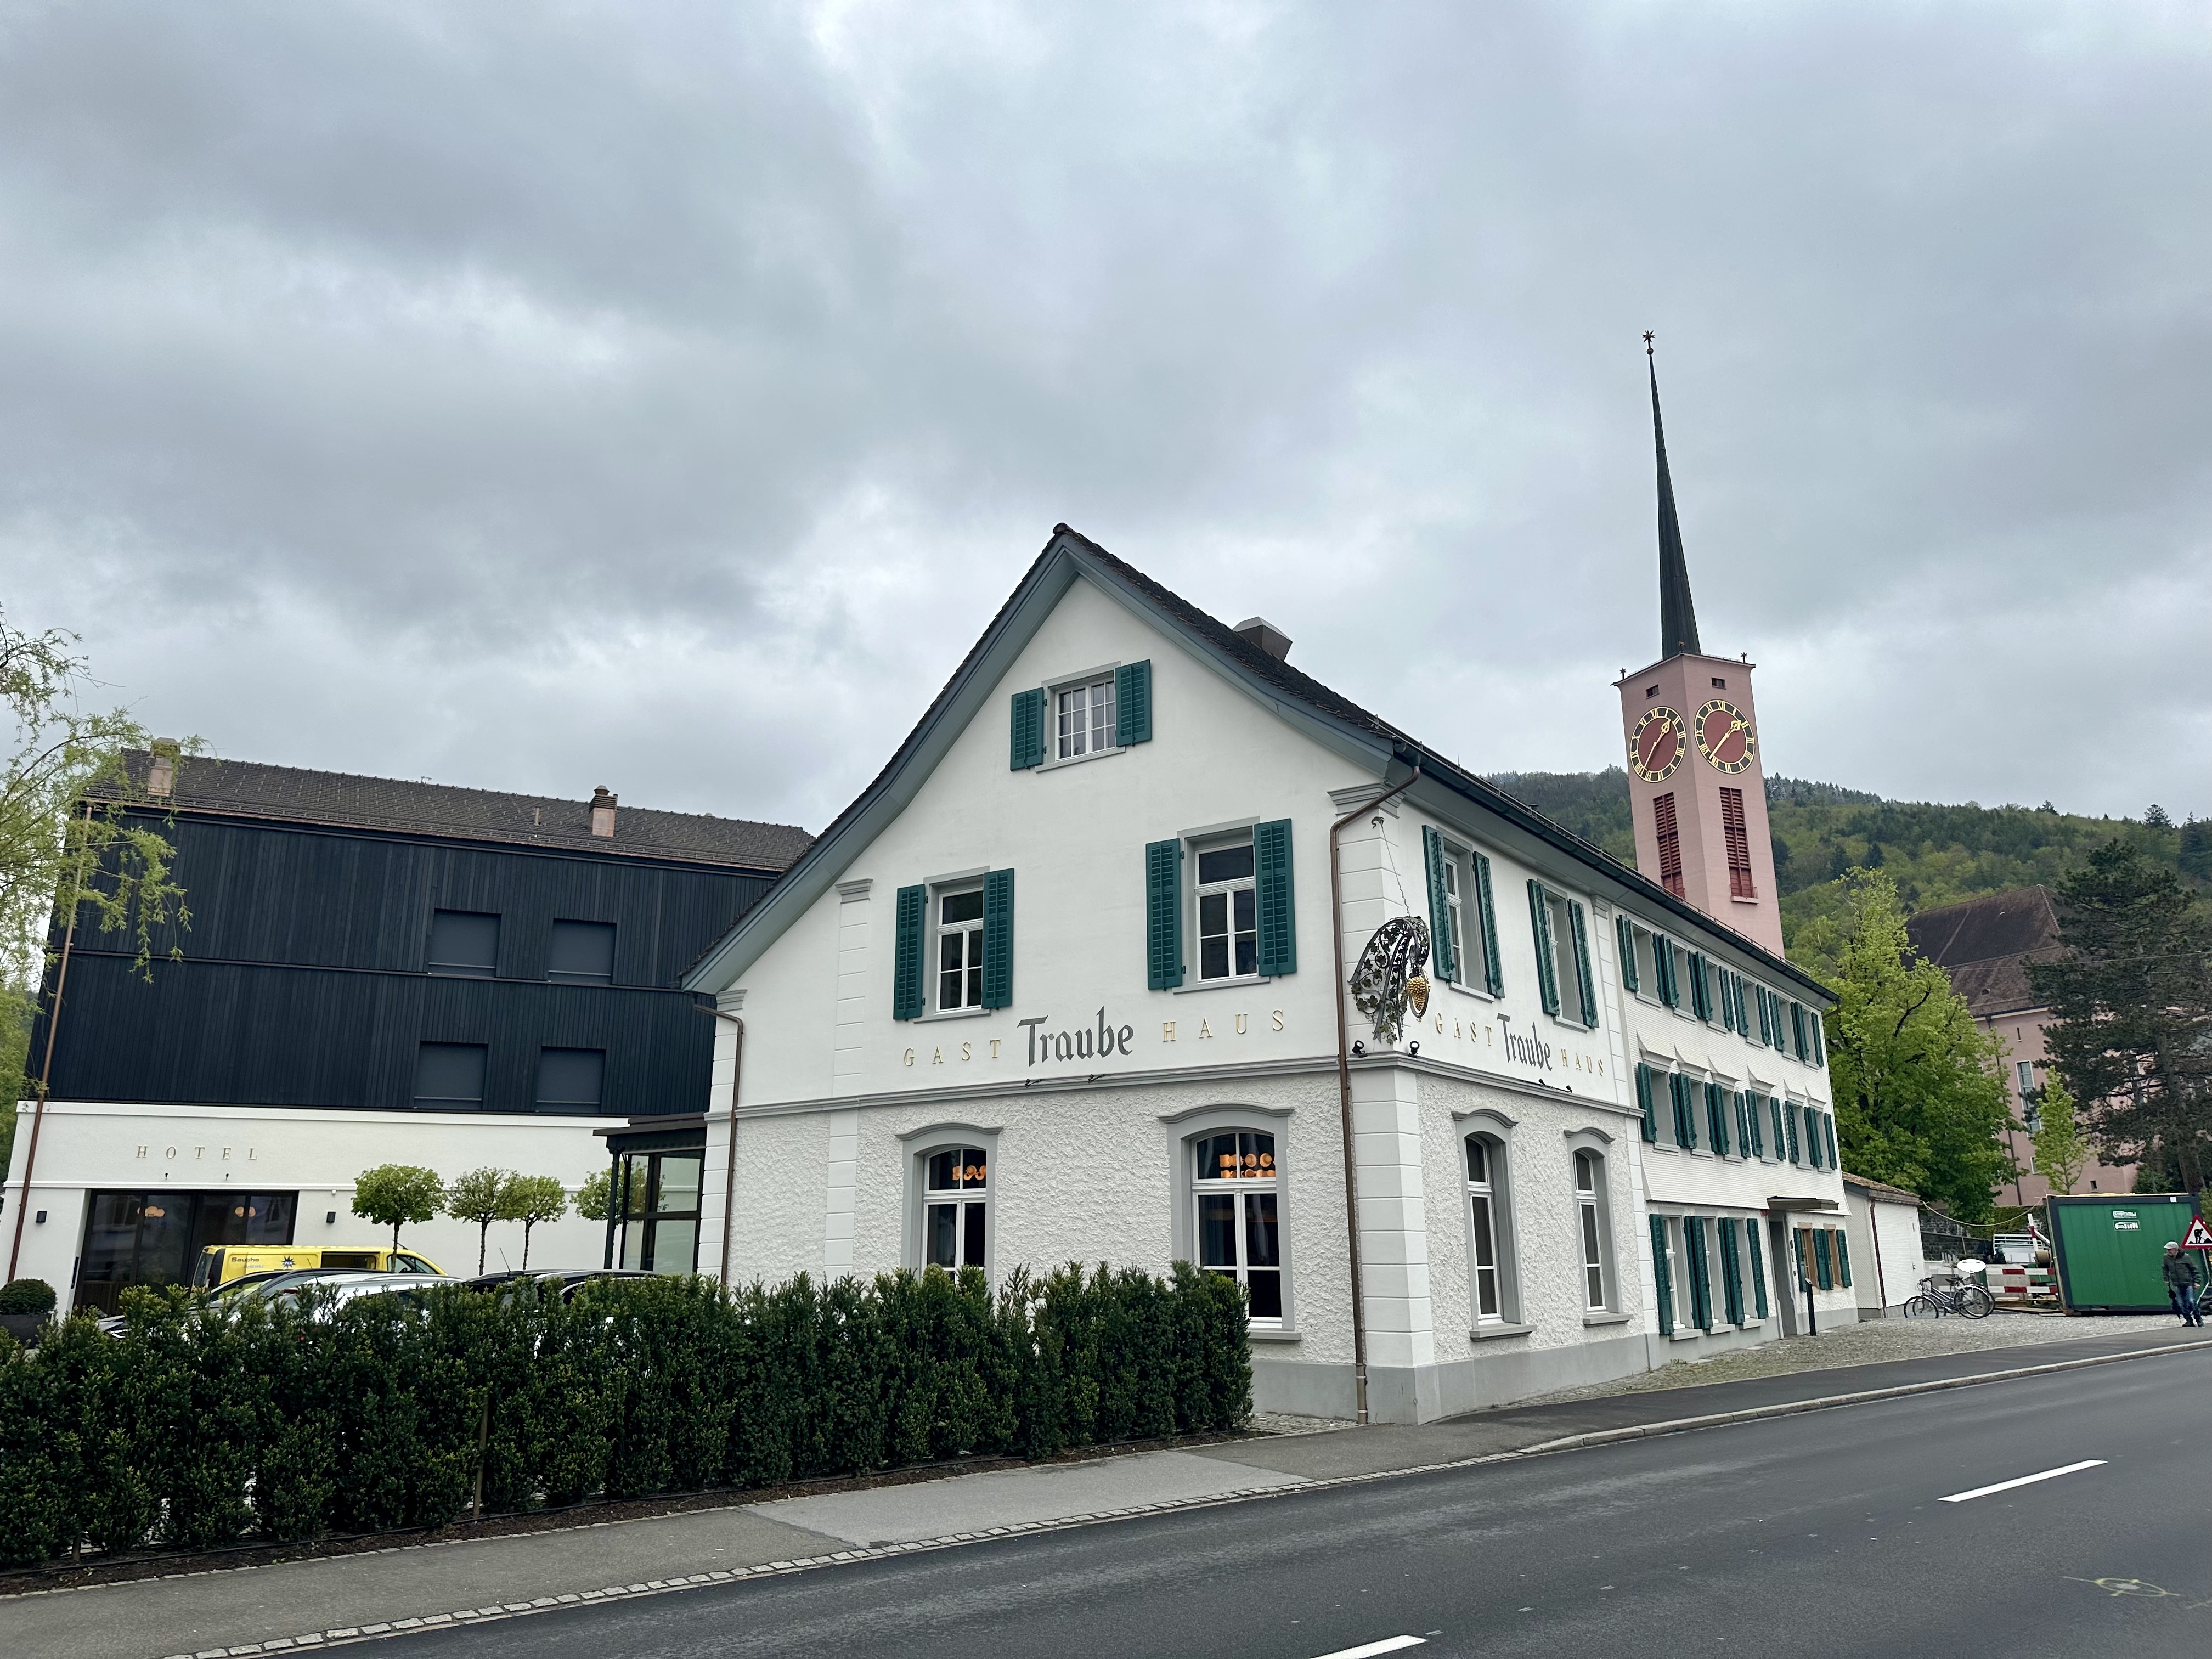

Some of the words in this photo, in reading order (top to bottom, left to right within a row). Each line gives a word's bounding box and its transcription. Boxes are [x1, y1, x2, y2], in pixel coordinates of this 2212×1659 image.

[904, 1039, 1001, 1066] GAST
[1017, 1006, 1134, 1068] Traube
[1163, 1009, 1283, 1042] HAUS
[1435, 1013, 1492, 1046] GAST
[1497, 1013, 1552, 1071] Traube
[1560, 1048, 1604, 1076] HAUS
[136, 1146, 257, 1160] HOTEL
